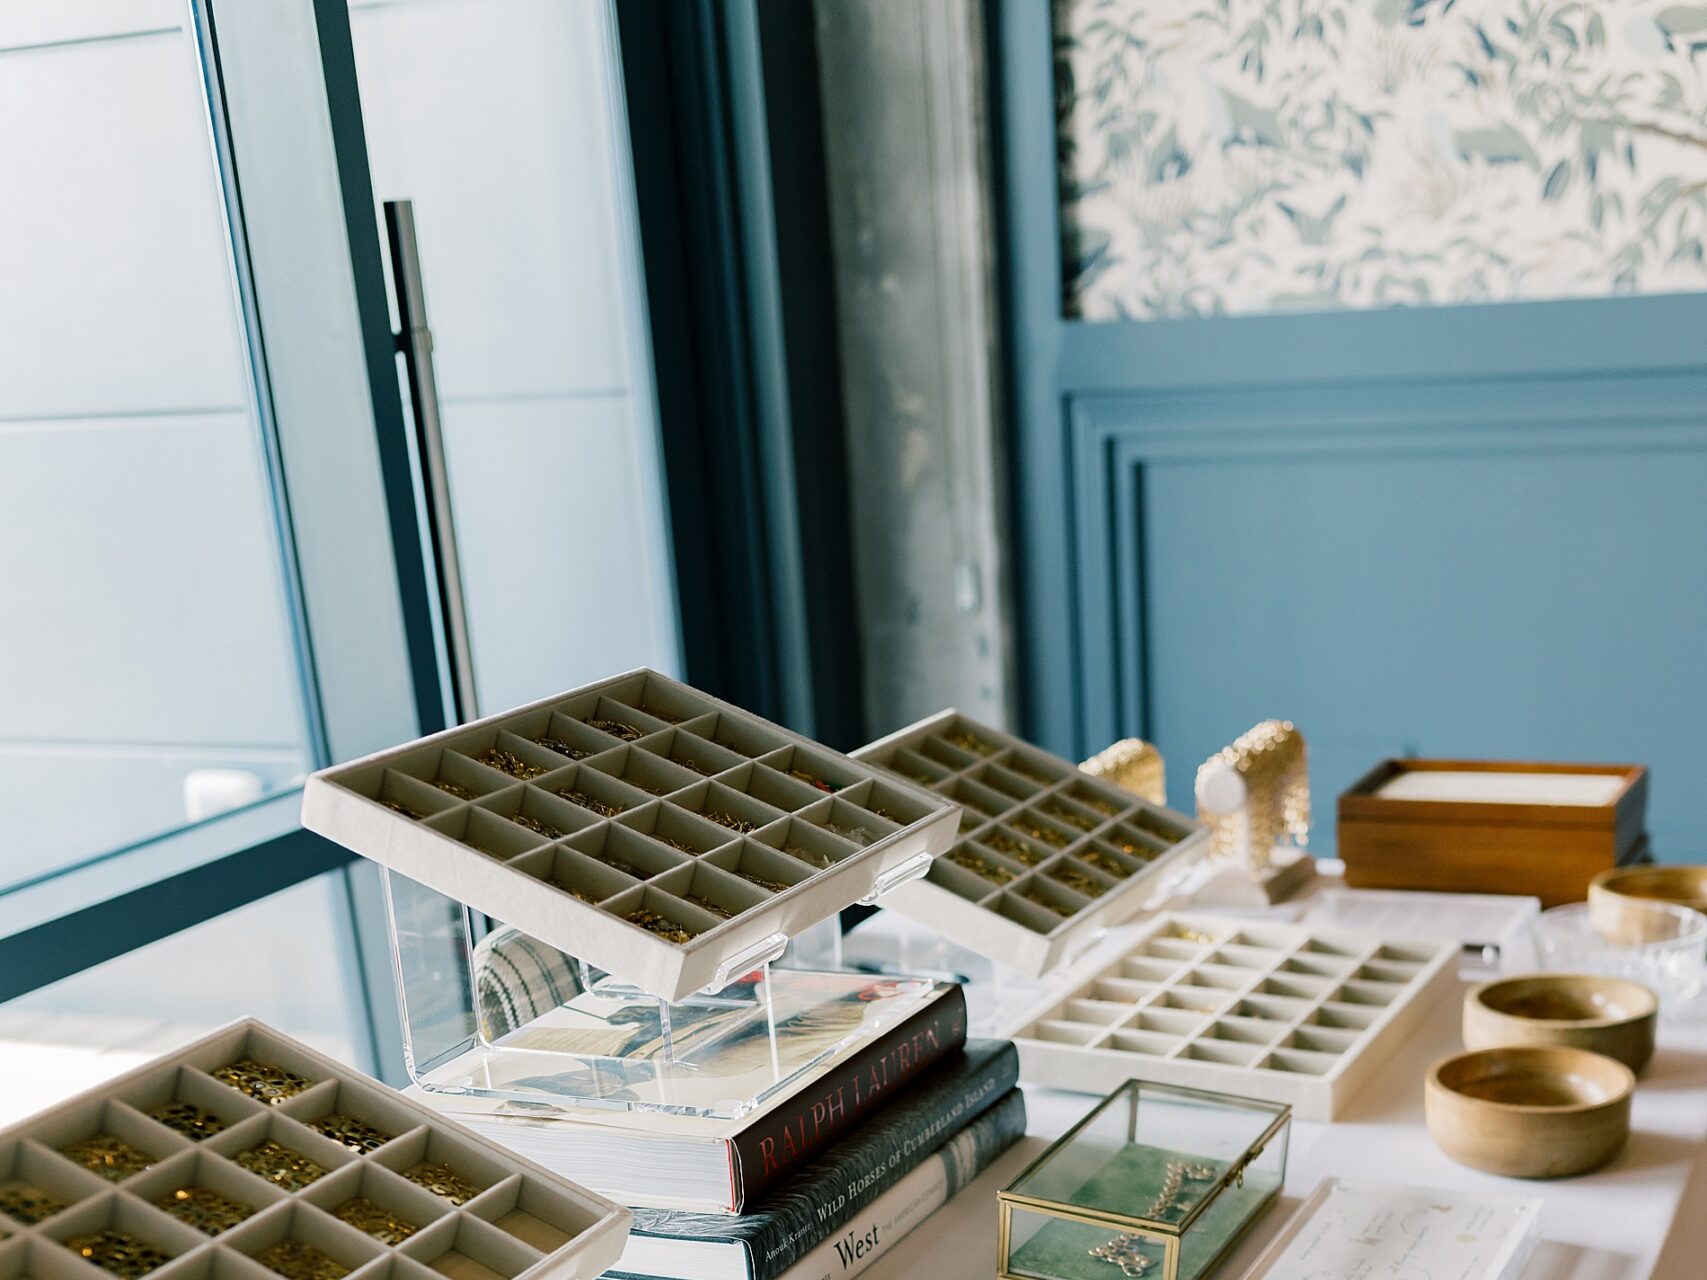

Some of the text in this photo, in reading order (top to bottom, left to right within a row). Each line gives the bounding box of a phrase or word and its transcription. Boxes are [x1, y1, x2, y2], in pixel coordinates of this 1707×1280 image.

[759, 1020, 941, 1177] RALPH LAUREN
[765, 1077, 996, 1262] Anouk Krantz WILD HORSES OF CUMBERLAND ISLAND
[833, 1223, 881, 1271] West
